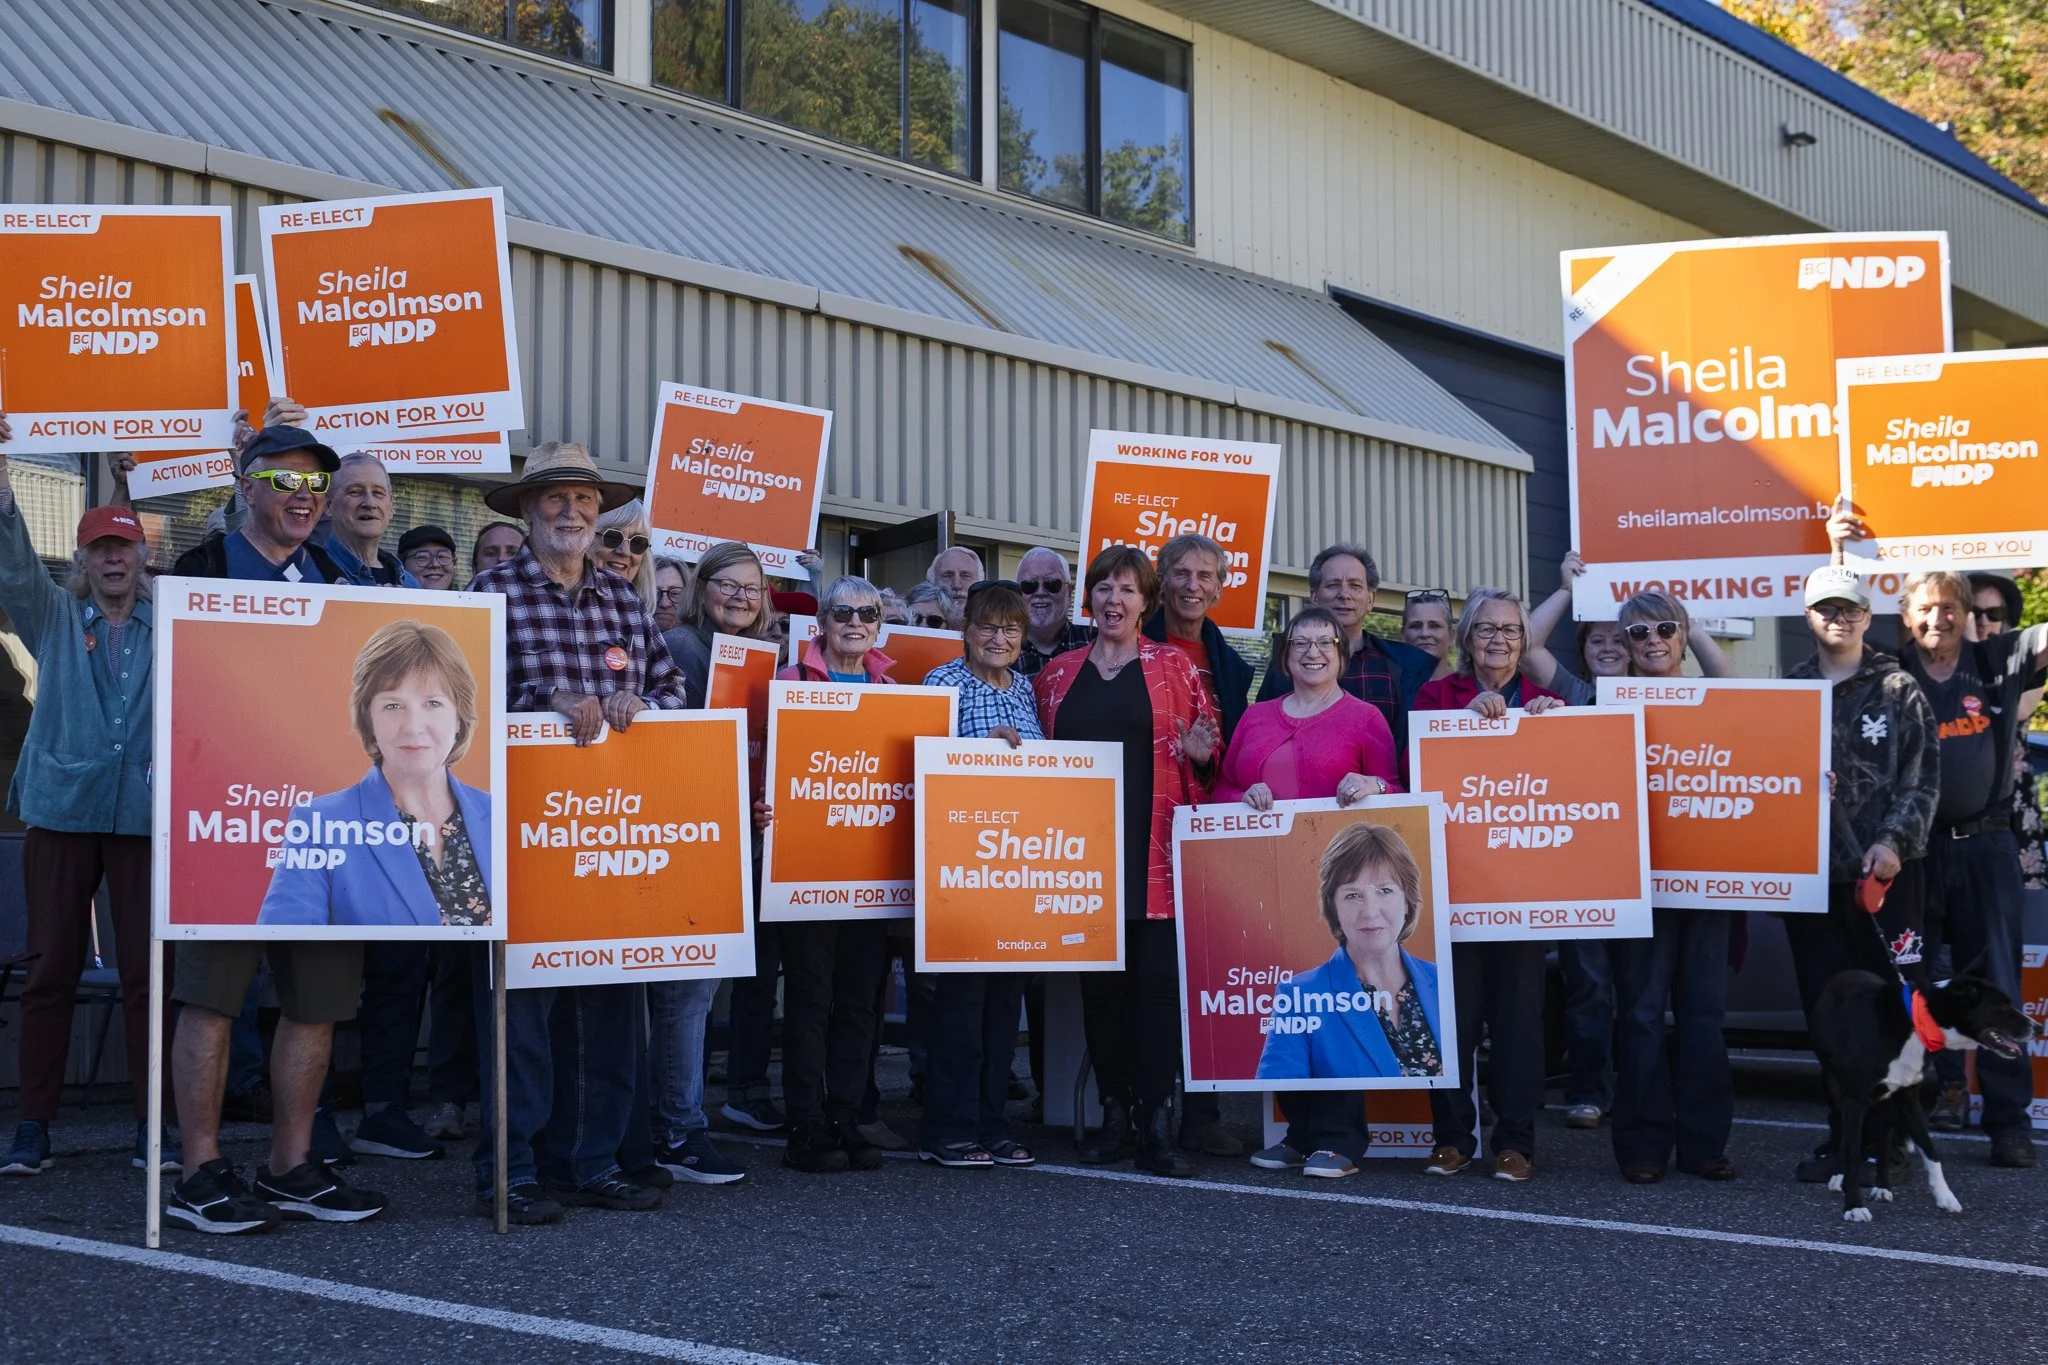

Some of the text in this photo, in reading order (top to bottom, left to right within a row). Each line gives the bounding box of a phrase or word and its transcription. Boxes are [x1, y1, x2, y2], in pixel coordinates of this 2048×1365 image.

[4, 214, 91, 228] RE-ELECT
[280, 207, 364, 228] RE-ELECT
[40, 275, 132, 299] Sheila
[317, 266, 407, 295] Sheila
[18, 302, 206, 328] Malcolmson
[297, 291, 483, 325] Malcolmson
[1625, 345, 1787, 396] Sheila
[674, 390, 735, 410] RE-ELECT
[29, 417, 202, 436] ACTION FOR YOU
[315, 402, 485, 430] ACTION FOR YOU
[1885, 415, 1970, 441] Sheila
[416, 449, 446, 461] FOR
[450, 449, 483, 461] YOU
[688, 437, 755, 463] Sheila
[1117, 444, 1253, 465] WORKING FOR YOU
[1866, 438, 2039, 466] Malcolmson
[151, 462, 202, 482] ACTION
[671, 453, 802, 492] Malcolmson
[1114, 492, 1179, 508] RE-ELECT
[1135, 510, 1237, 543] Sheila
[757, 550, 787, 565] YOU
[1877, 540, 2033, 559] ACTION FOR YOU
[188, 592, 311, 617] RE-ELECT
[786, 690, 853, 705] RE-ELECT
[1616, 686, 1697, 700] RE-ELECT
[1429, 717, 1510, 732] RE-ELECT
[808, 751, 879, 774] Sheila
[946, 753, 1094, 769] WORKING FOR YOU
[1646, 743, 1732, 767] Sheila
[225, 783, 313, 808] Sheila
[790, 776, 915, 801] Malcolmso
[1460, 773, 1548, 798] Sheila
[543, 788, 642, 817] Sheila
[1443, 798, 1620, 825] Malcolmson
[188, 810, 436, 847] Malcolmson
[948, 810, 1020, 824] RE-ELECT
[1190, 812, 1284, 833] RE-ELECT
[521, 818, 720, 849] Malcolmson
[975, 827, 1086, 860] Sheila
[940, 864, 1103, 889] Malcolmson
[1705, 880, 1747, 895] FOR
[1750, 881, 1792, 896] YOU
[789, 889, 849, 905] ACTION
[854, 888, 885, 903] FOR
[1450, 908, 1616, 926] ACTION FOR YOU
[531, 944, 716, 969] ACTION FOR YOU
[997, 939, 1047, 951] bcndp.ca
[1227, 965, 1294, 986] Sheila
[1200, 987, 1393, 1016] Malcolmson
[1370, 1130, 1404, 1144] FOR
